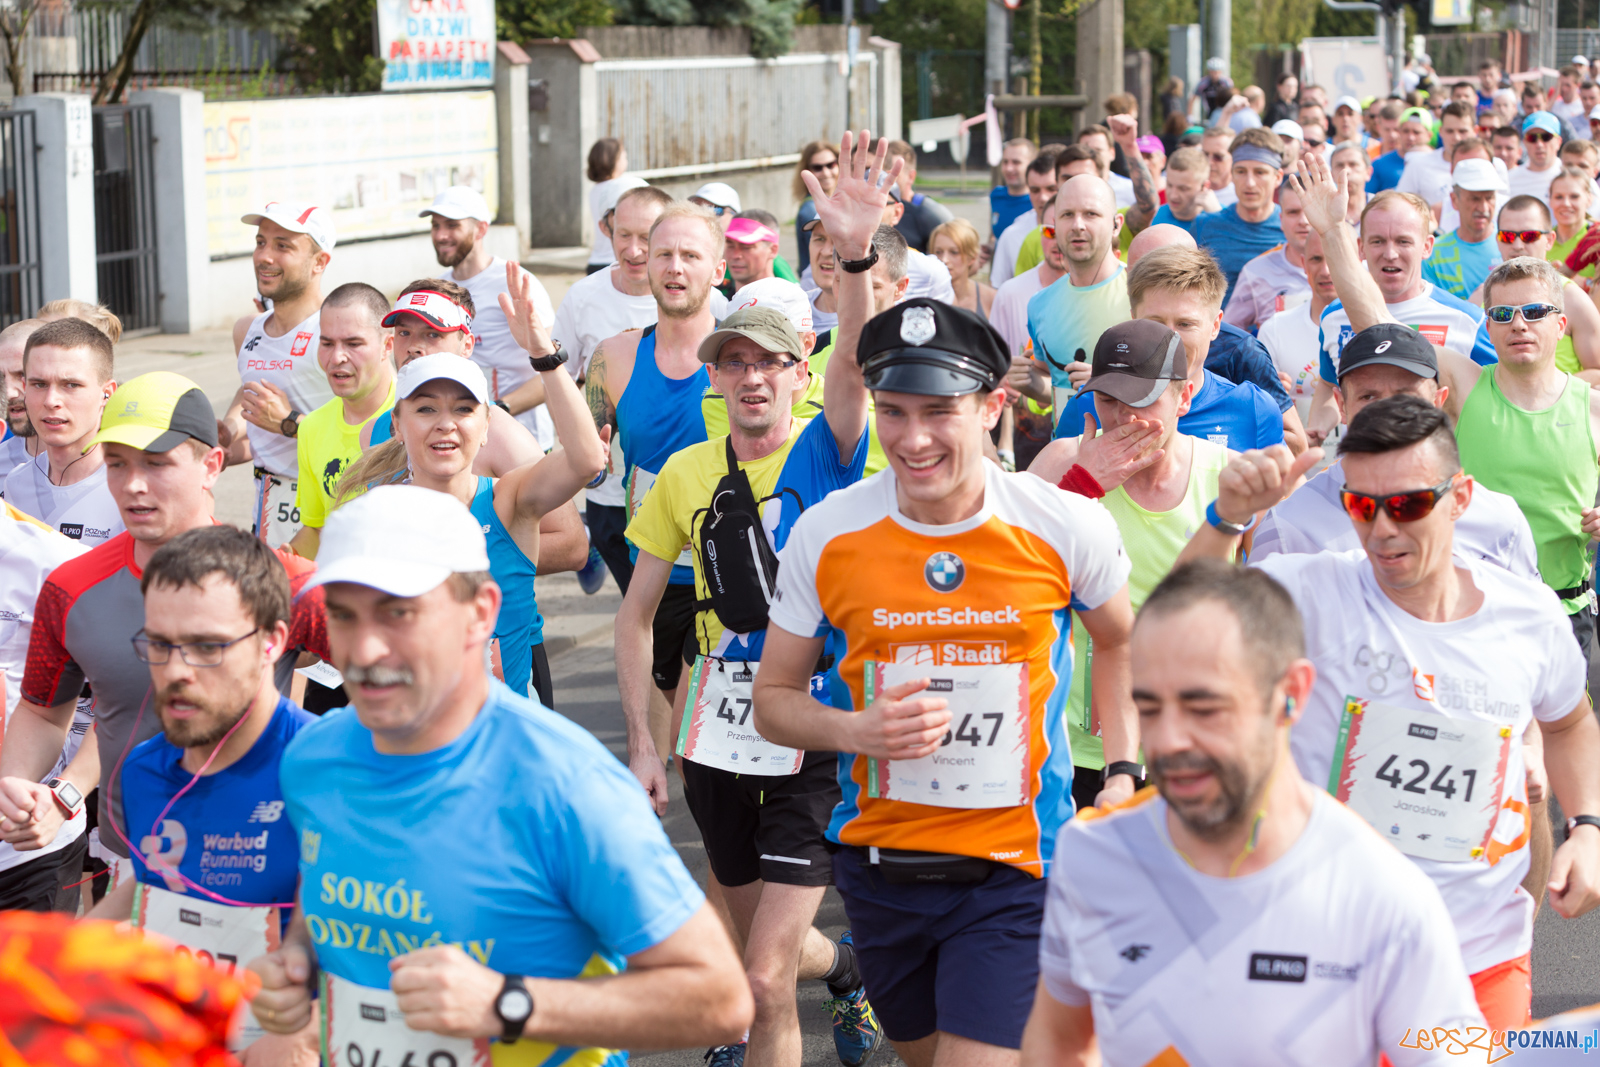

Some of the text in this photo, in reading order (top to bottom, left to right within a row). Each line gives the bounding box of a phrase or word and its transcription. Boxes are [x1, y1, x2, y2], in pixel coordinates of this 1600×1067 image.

[407, 17, 471, 36] DRZWI
[389, 40, 488, 59] PARAPETY
[246, 359, 293, 370] POLSKA
[712, 561, 725, 594] Kalenji
[873, 605, 1021, 629] SportScheck
[943, 643, 1001, 663] Stadt
[931, 755, 975, 766] Vincent
[1375, 754, 1477, 803] 4241
[1393, 799, 1448, 818] Jarosław
[203, 830, 269, 850] Warbud
[200, 850, 267, 873] Running
[200, 868, 242, 886] Team
[320, 872, 433, 926] SOKÓŁ
